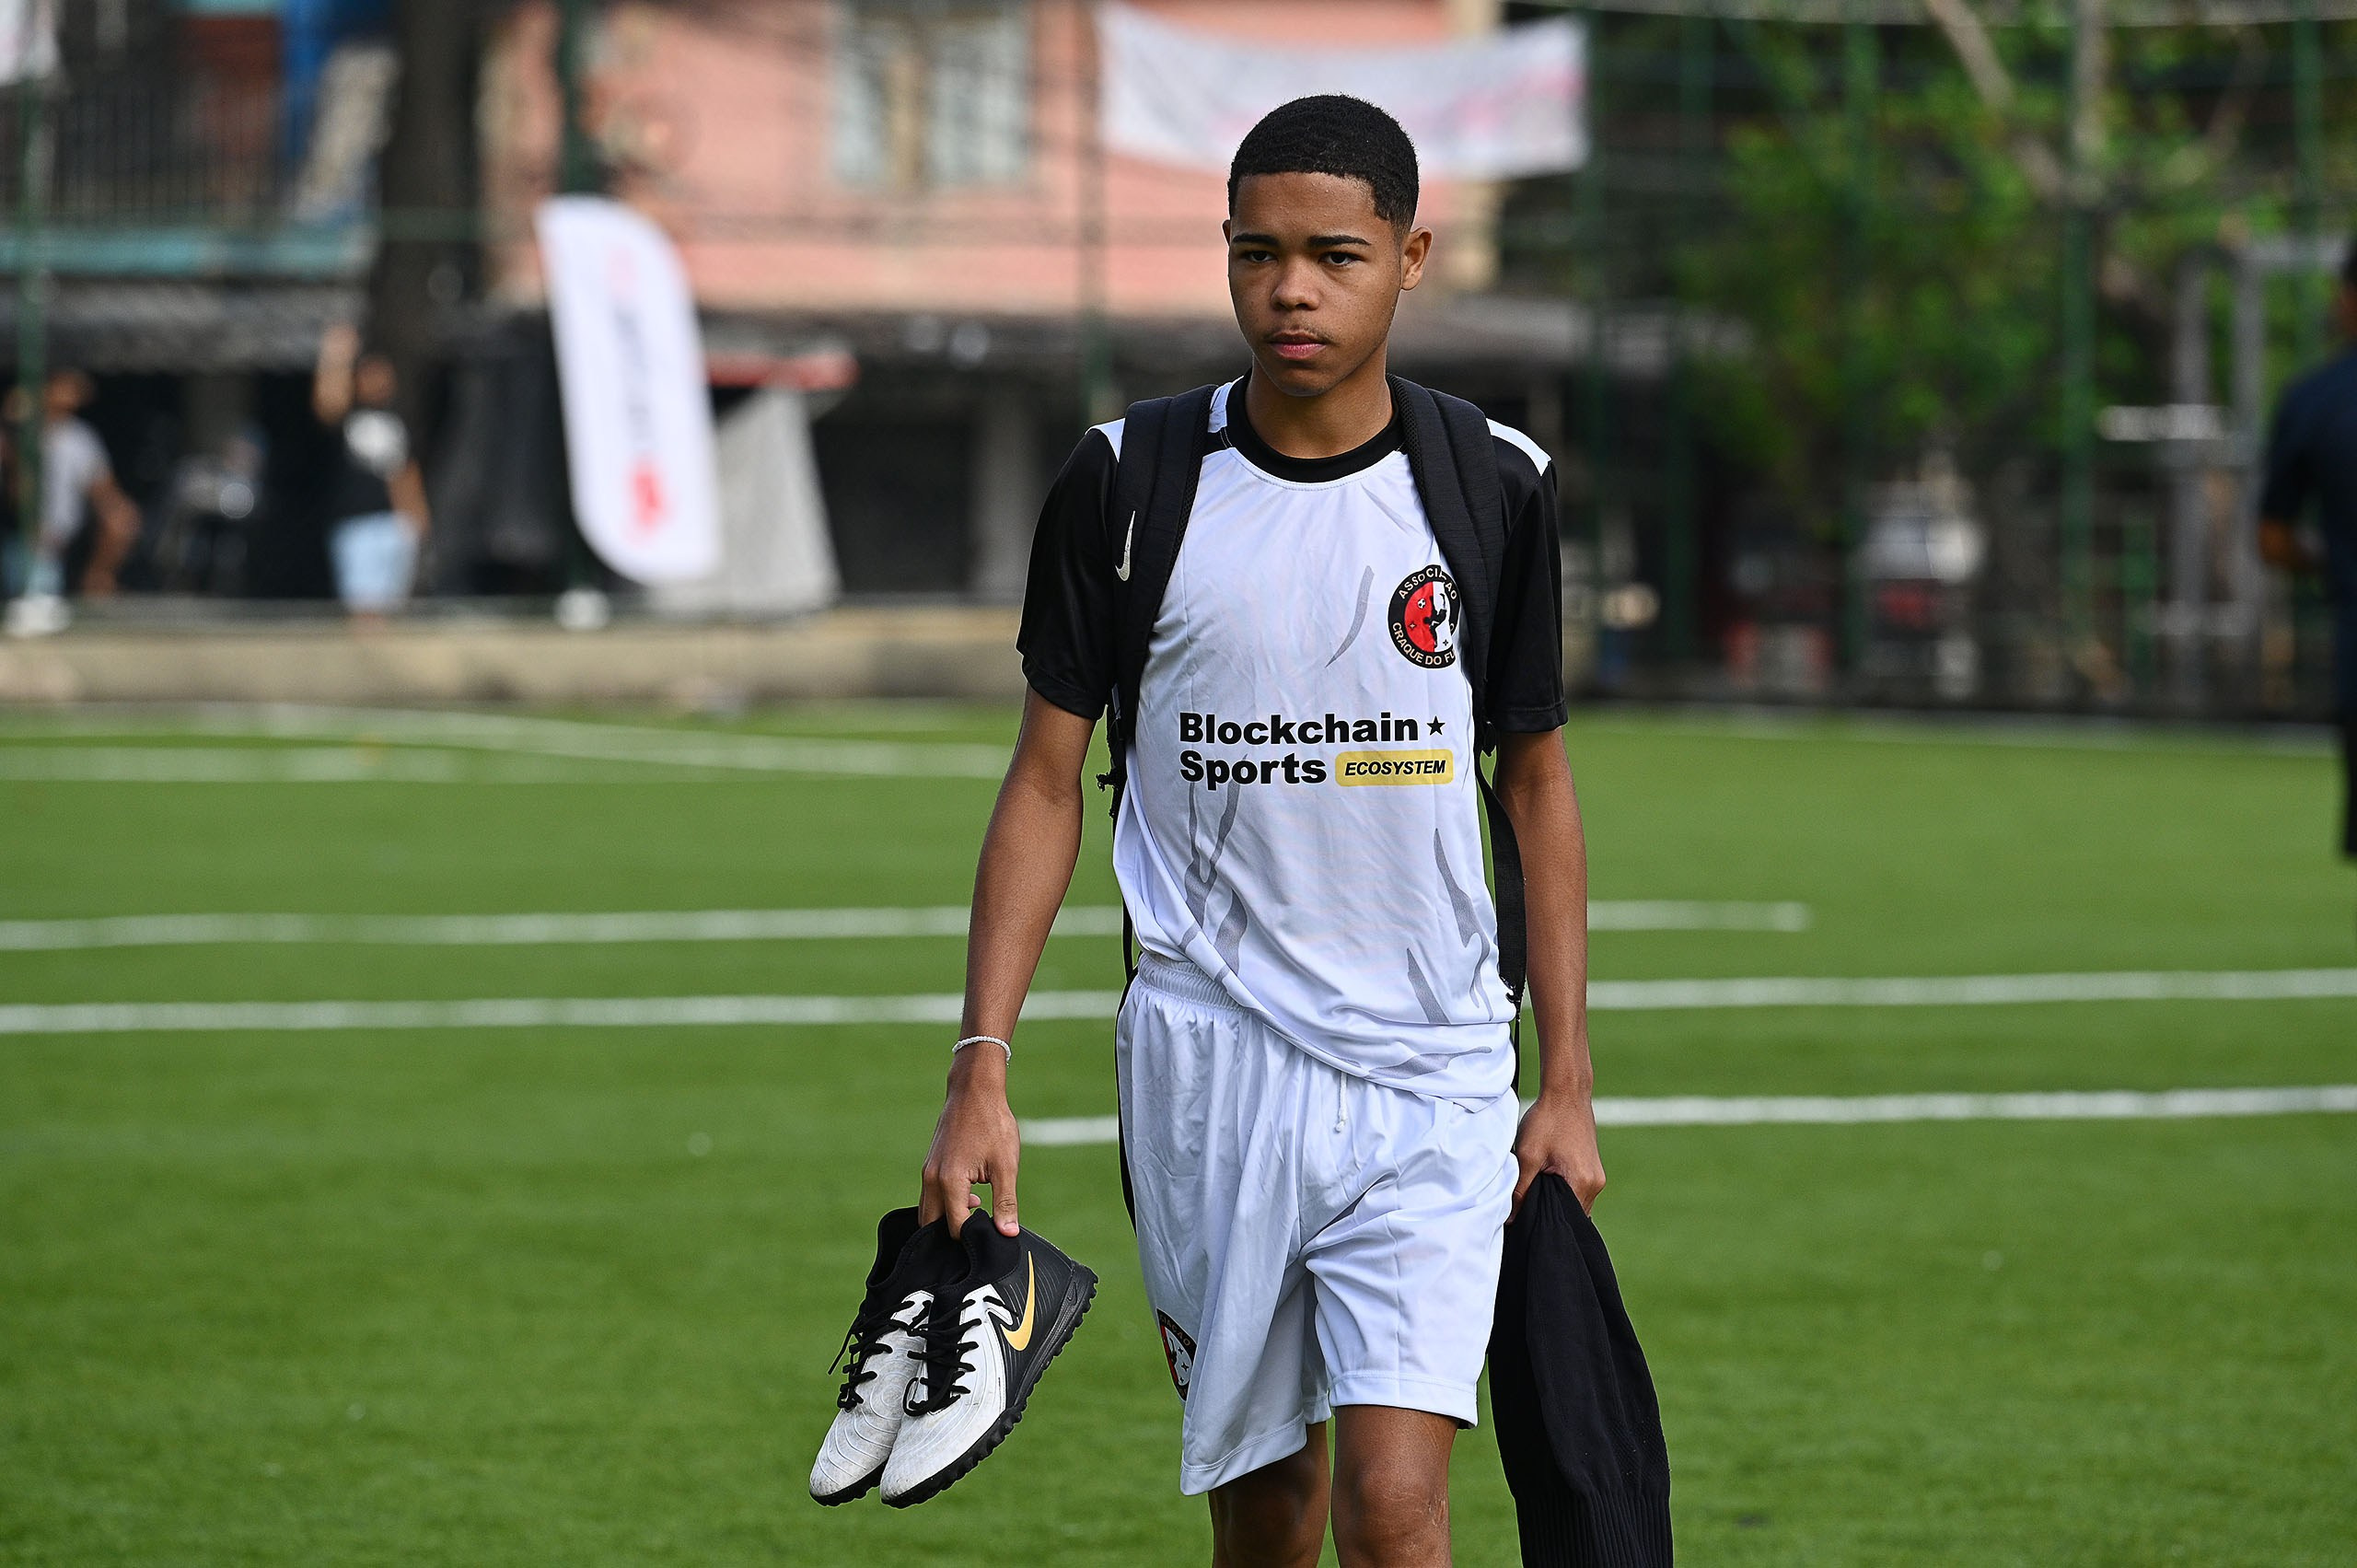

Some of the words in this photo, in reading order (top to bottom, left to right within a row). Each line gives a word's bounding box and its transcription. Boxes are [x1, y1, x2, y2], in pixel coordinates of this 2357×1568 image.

[1392, 621, 1423, 664] CRAQUE
[1424, 655, 1443, 666] DO
[1179, 712, 1419, 745] Blockchain
[1179, 749, 1328, 792] Sports
[1344, 760, 1446, 777] ECOSYSTEM
